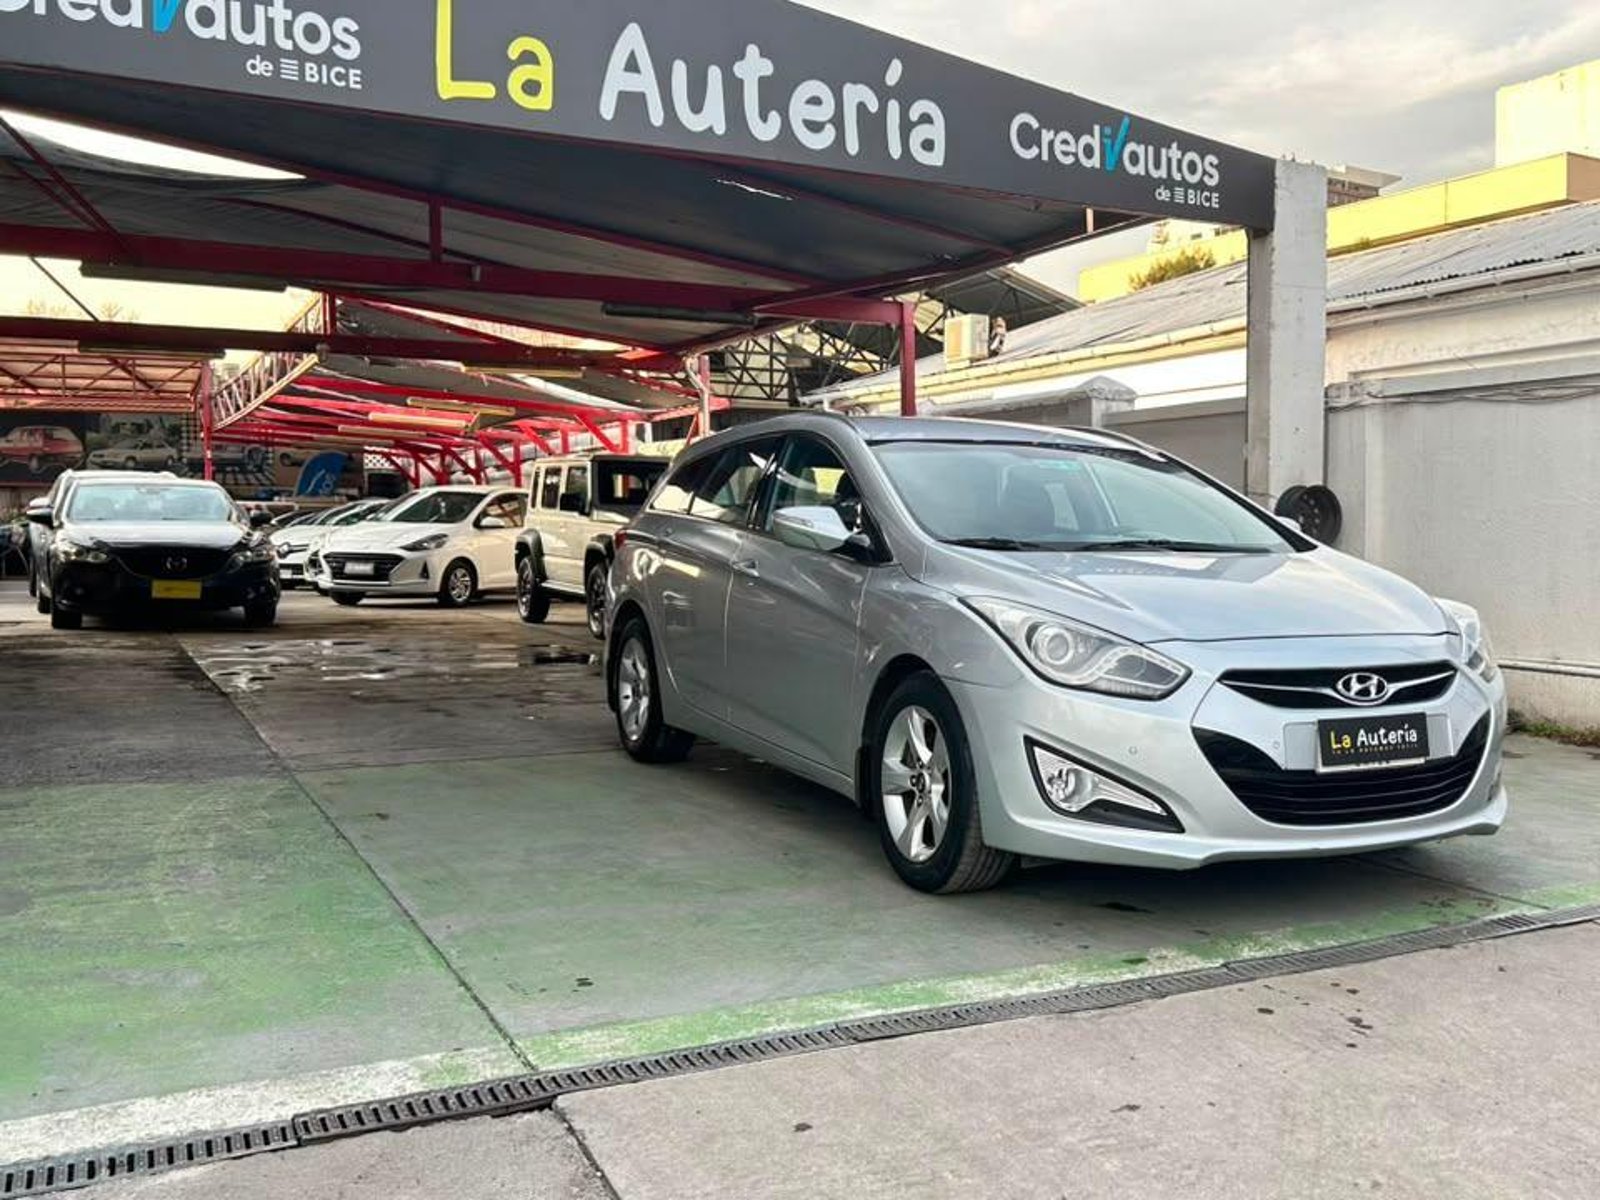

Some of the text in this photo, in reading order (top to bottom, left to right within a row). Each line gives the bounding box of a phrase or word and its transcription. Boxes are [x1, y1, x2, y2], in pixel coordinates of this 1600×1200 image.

[246, 55, 362, 90] de BICE
[436, 0, 946, 166] La Autería
[1154, 184, 1220, 209] de BICE
[1330, 730, 1352, 749] La
[1357, 723, 1418, 747] Autería
